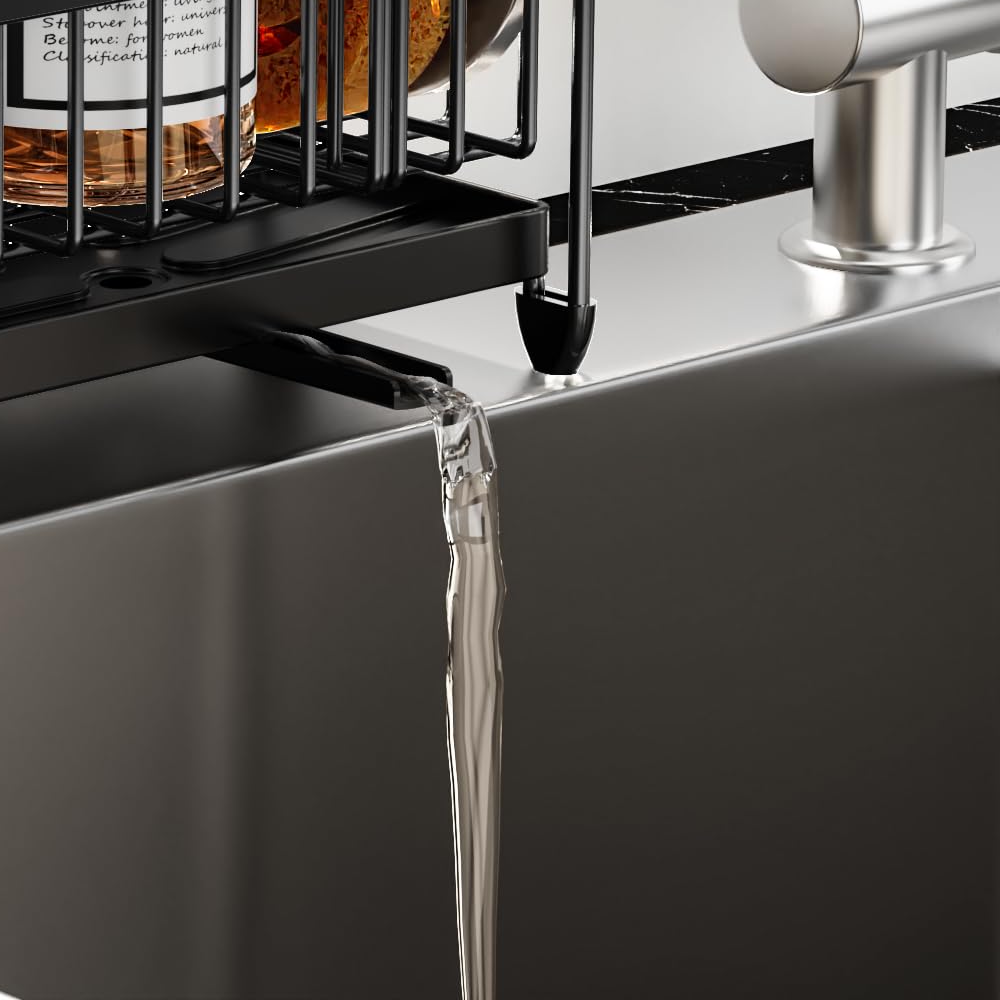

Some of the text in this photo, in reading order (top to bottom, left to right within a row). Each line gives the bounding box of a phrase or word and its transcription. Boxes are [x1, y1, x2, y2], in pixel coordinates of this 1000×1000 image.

[43, 33, 119, 46] Beme:
[163, 28, 204, 41] omen
[174, 37, 223, 56] natural
